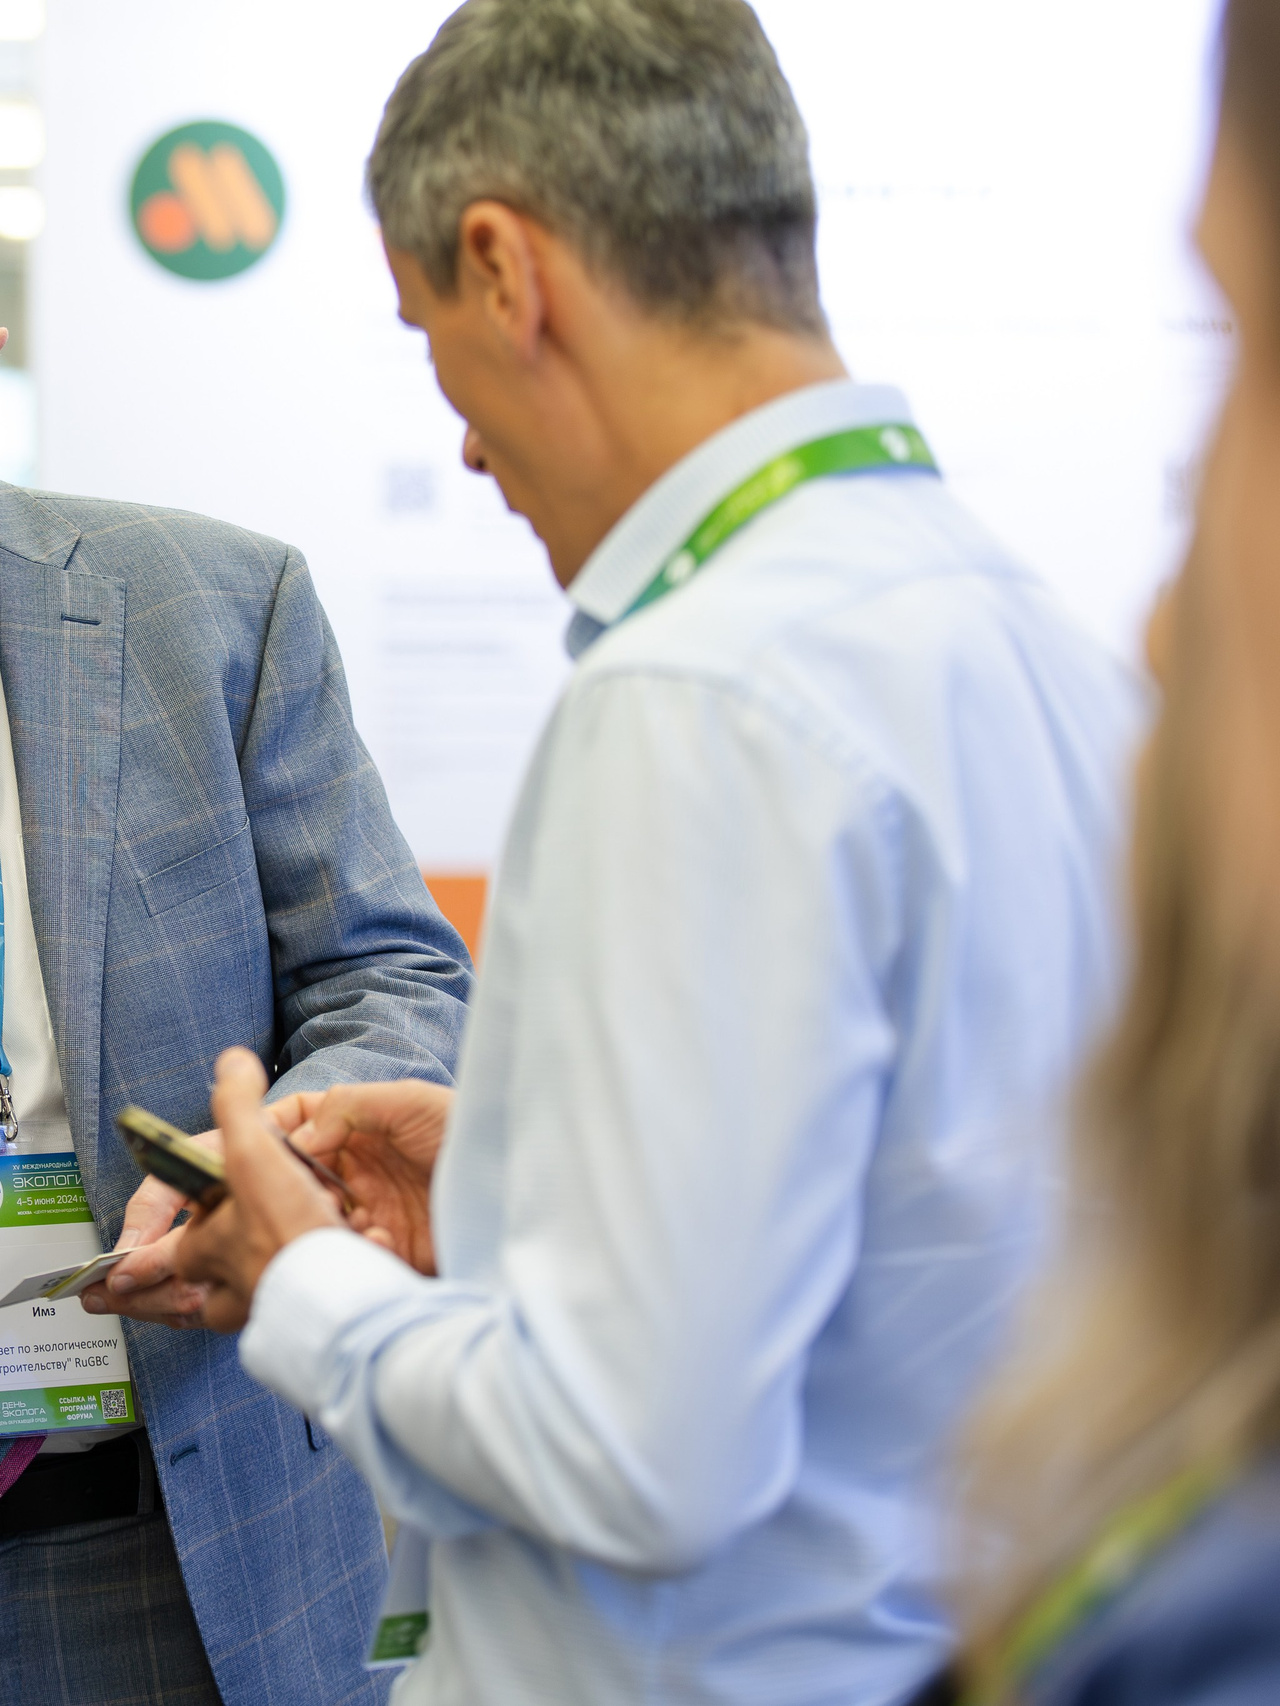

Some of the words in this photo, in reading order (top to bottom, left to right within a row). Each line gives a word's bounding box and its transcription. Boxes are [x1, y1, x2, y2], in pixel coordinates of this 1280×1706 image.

[21, 1160, 72, 1170] МЕЖДУНАРОДНЫЙ
[12, 1174, 82, 1189] ЭКОЛОГИ
[34, 1197, 55, 1206] июня
[56, 1194, 78, 1204] 2024
[32, 1306, 56, 1317] Имз
[18, 1344, 31, 1354] по
[33, 1338, 118, 1353] экологическому
[75, 1355, 109, 1368] RuGBC
[58, 1396, 86, 1404] ССЫЛКА
[1, 1401, 26, 1410] ДЕНЬ
[60, 1403, 98, 1413] ПРОГРАММУ
[2, 1408, 46, 1418] ЭКОЛОГА
[66, 1412, 94, 1420] ФОРУМА
